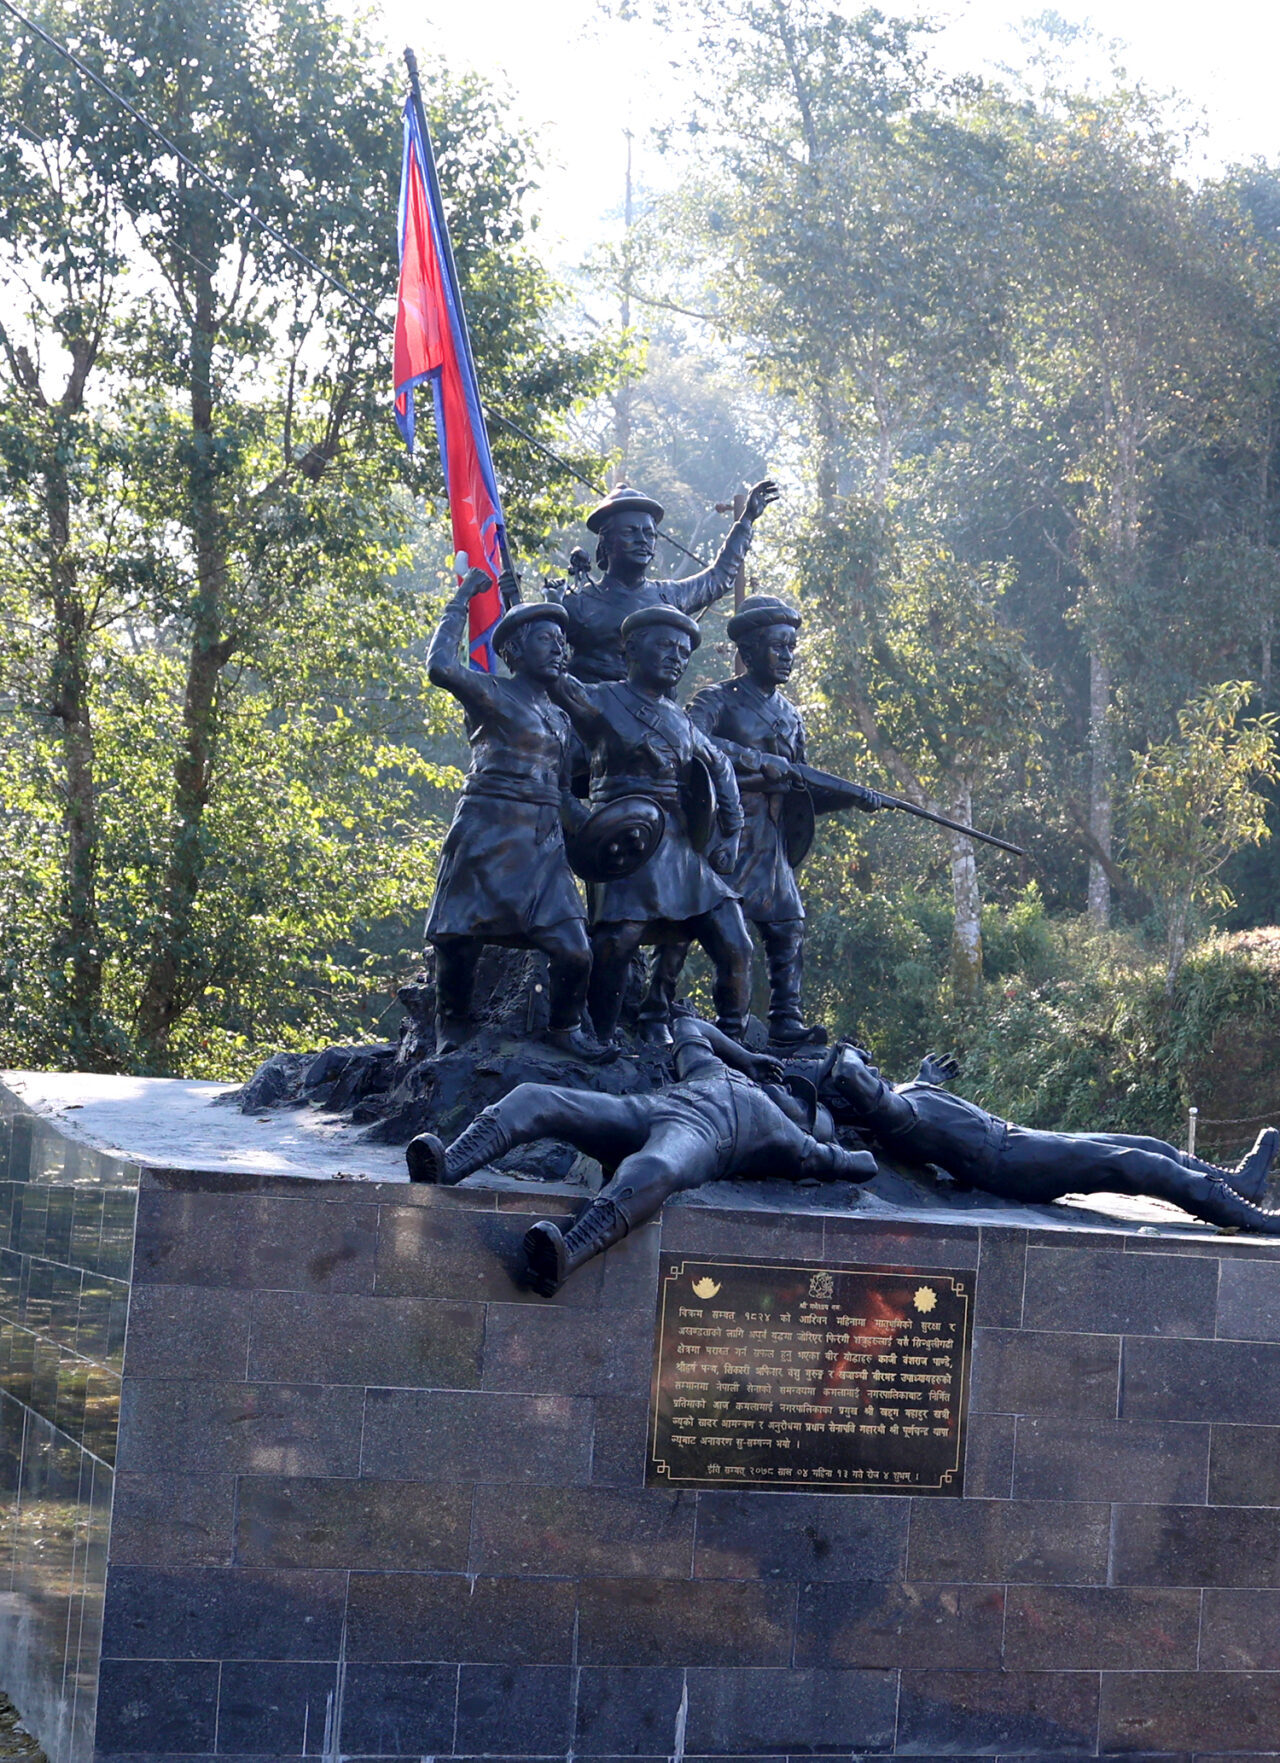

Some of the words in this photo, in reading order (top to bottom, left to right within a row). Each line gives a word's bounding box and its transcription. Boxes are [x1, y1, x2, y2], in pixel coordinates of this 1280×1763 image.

[743, 1311, 771, 1322] १८२४
[779, 1311, 791, 1322] को
[835, 1314, 866, 1326] महिनामा
[920, 1321, 941, 1333] सुरक्षा
[725, 1326, 744, 1338] लागि
[676, 1342, 700, 1354] क्षेत्रमा
[734, 1345, 747, 1356] गर्न
[797, 1350, 820, 1361] भएका
[877, 1351, 897, 1364] काजी
[673, 1380, 709, 1390] सम्मानमा
[715, 1380, 740, 1391] नेपाली
[745, 1381, 773, 1393] सेनाको
[779, 1385, 816, 1395] समन्वयमा
[822, 1386, 860, 1398] कमलामाई
[672, 1396, 707, 1408] प्रतिमाको
[712, 1400, 730, 1409] आज
[735, 1400, 774, 1412] कमलामाई
[779, 1401, 833, 1414] नगरपालिकाका
[837, 1405, 859, 1418] प्रमुख
[863, 1404, 874, 1415] श्री
[767, 1418, 802, 1434] अनुरोधमा
[803, 1422, 825, 1432] प्रधान
[888, 1423, 899, 1435] श्री
[774, 1436, 791, 1448] भयो
[749, 1466, 774, 1476] २०७८
[795, 1468, 808, 1477] ०४
